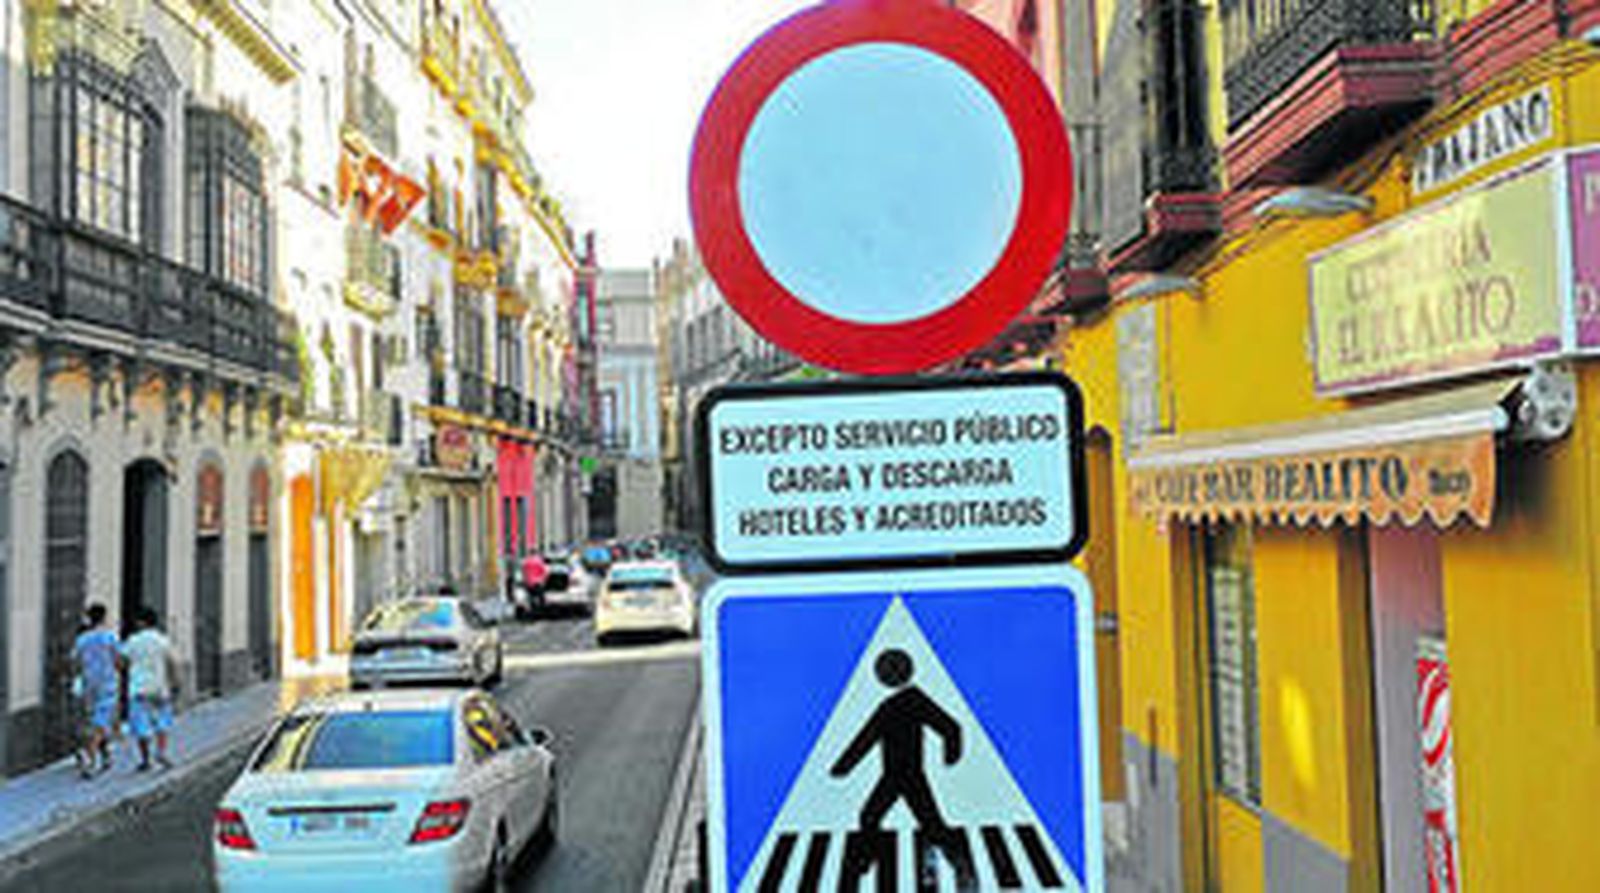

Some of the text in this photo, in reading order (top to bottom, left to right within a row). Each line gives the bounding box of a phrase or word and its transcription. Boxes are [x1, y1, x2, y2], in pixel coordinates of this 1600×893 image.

[720, 410, 1060, 455] EXCEPTO SERVICIO PÚBLICO
[767, 458, 1013, 494] CARGA Y DESCARGA
[738, 498, 1047, 536] HOTELES Y ACREDITADOS
